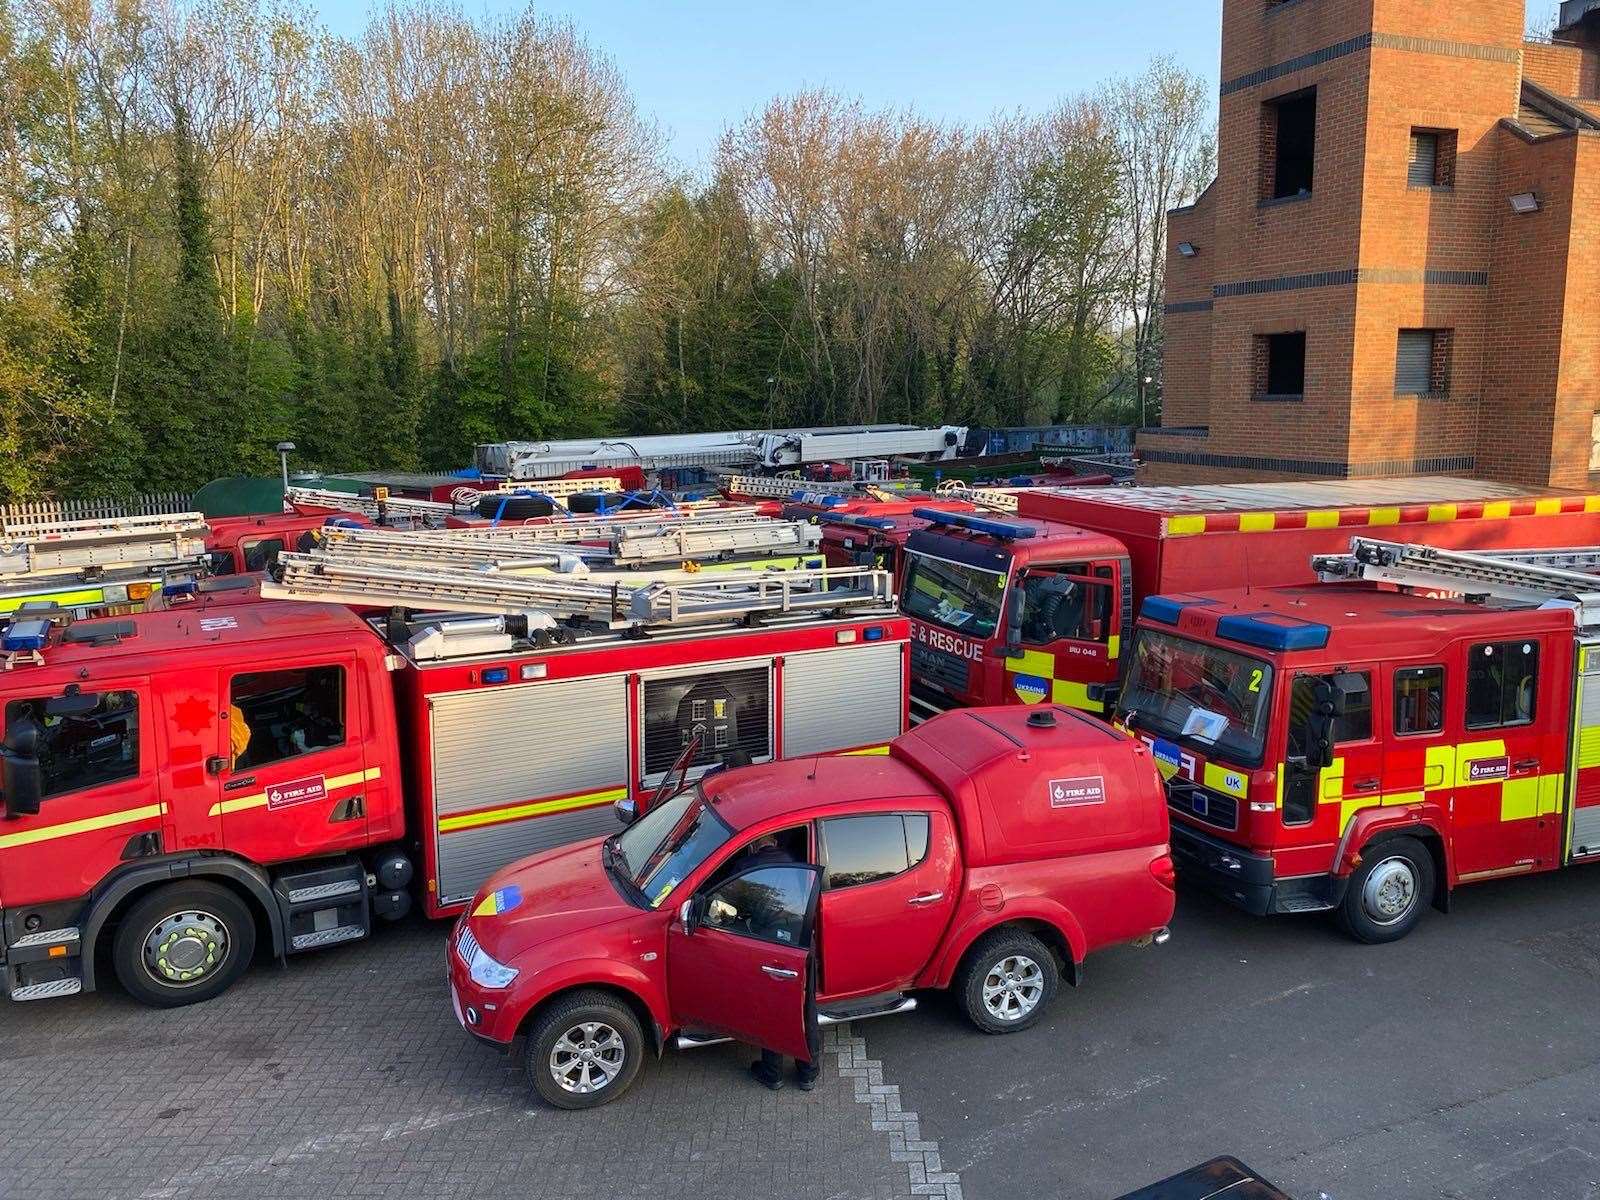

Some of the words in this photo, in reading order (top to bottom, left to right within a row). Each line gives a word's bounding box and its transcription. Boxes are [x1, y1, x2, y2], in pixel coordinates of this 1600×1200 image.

[918, 626, 927, 643] &
[929, 629, 984, 663] RESCUE
[1248, 669, 1263, 693] 2
[1016, 683, 1045, 695] UKRAINE
[1225, 776, 1241, 789] UK
[283, 788, 306, 799] FIRE
[306, 785, 323, 795] AID
[1065, 788, 1086, 797] FIRE
[1086, 787, 1101, 796] AID
